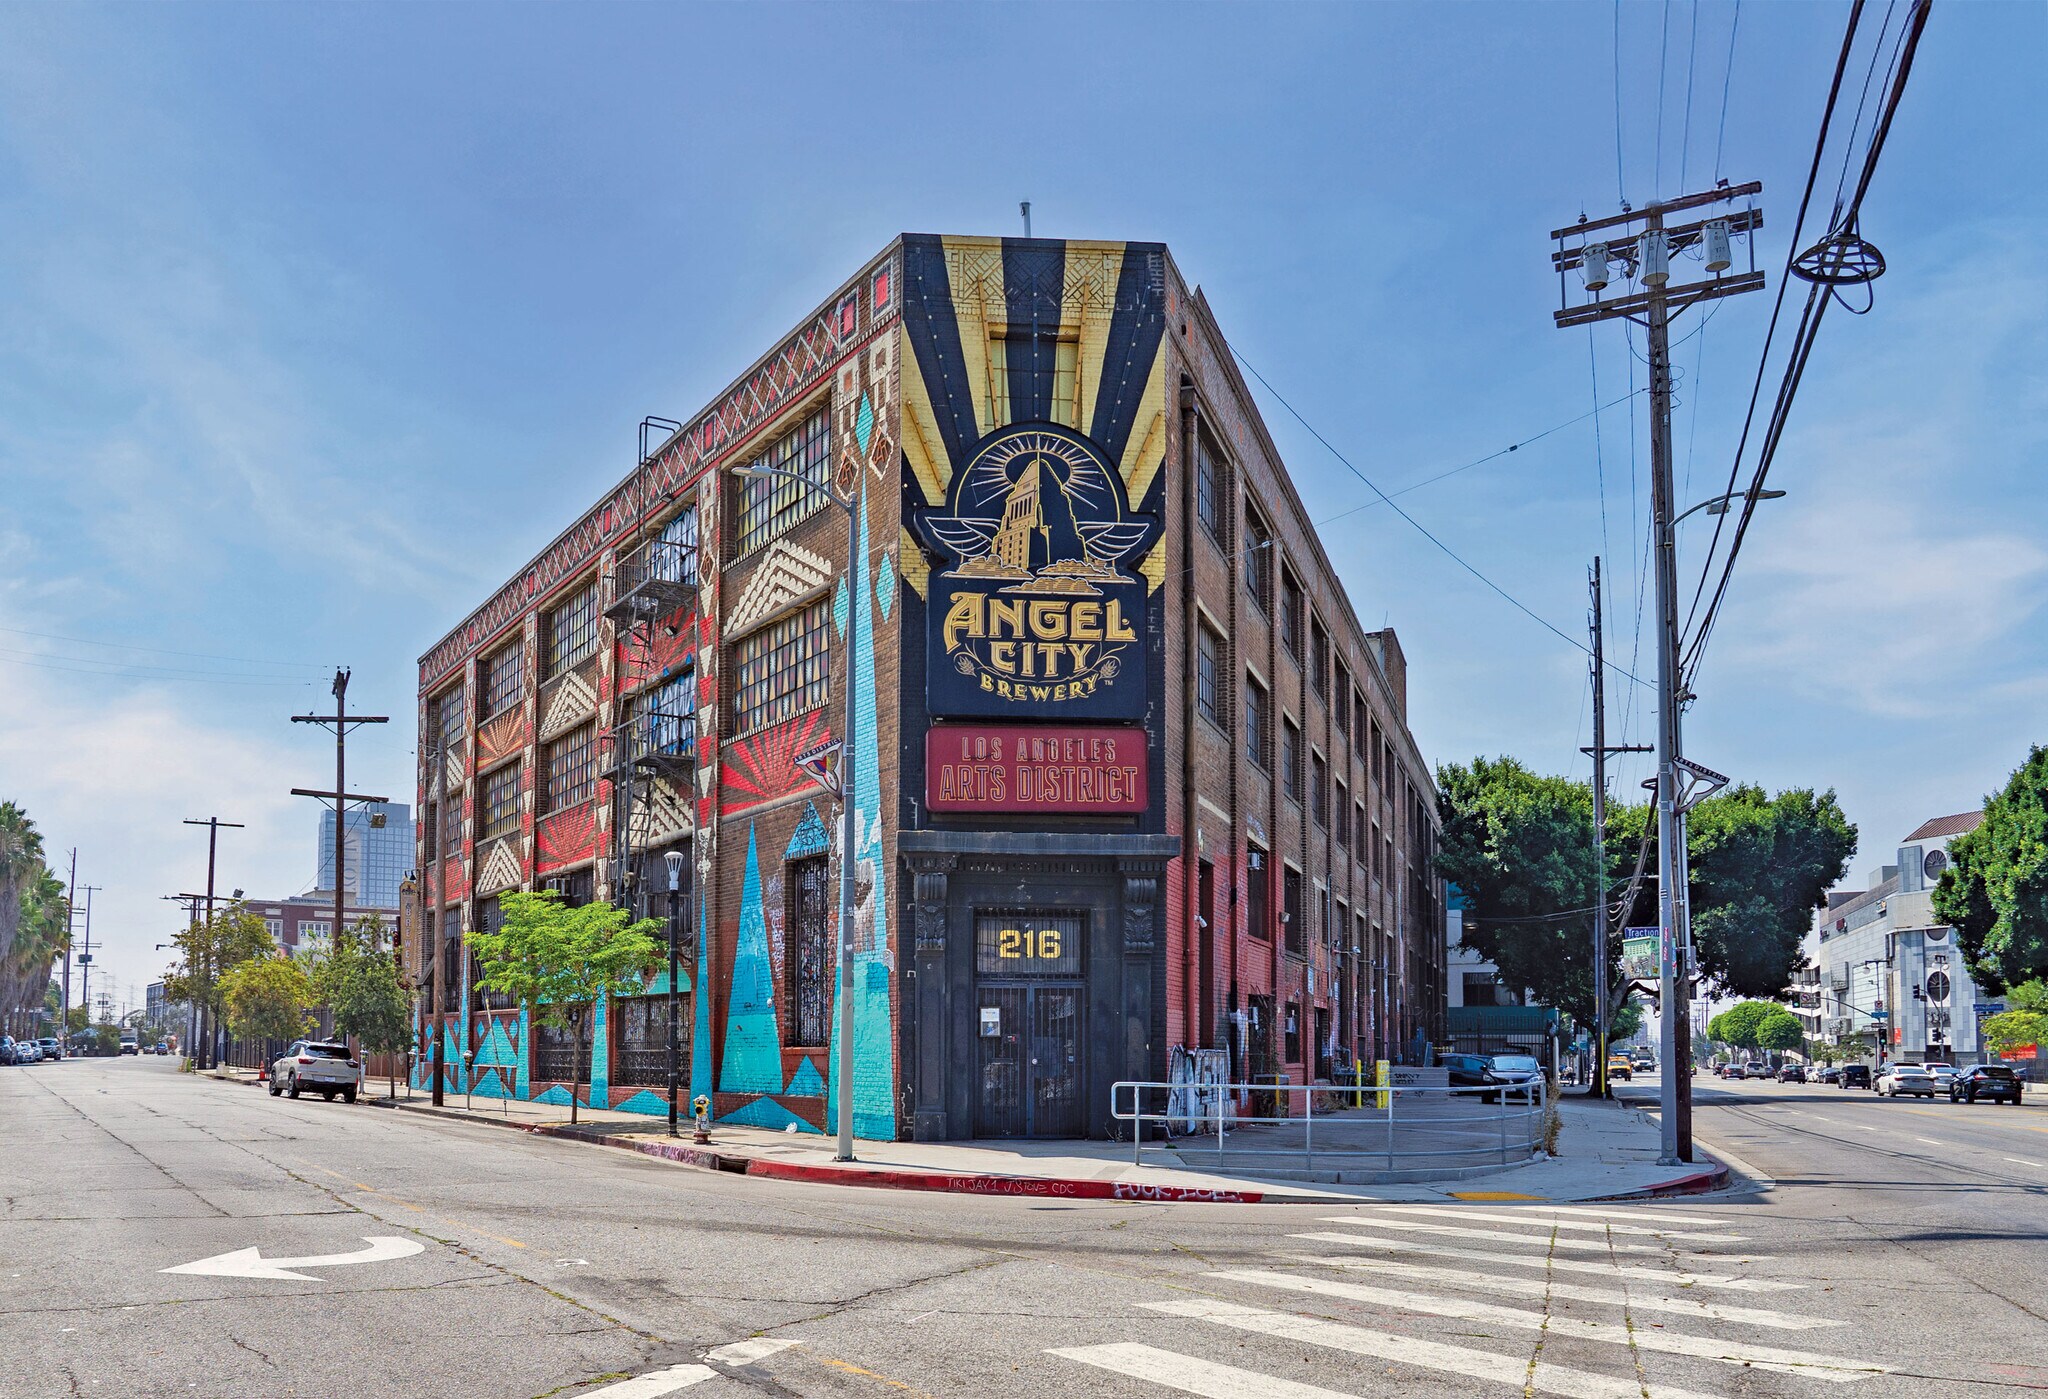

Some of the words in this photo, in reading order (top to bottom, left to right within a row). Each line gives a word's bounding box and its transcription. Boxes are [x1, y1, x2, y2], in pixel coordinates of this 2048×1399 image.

[943, 591, 1138, 654] ANGEL
[989, 641, 1096, 678] CITY
[980, 672, 1100, 702] BREWERY
[793, 751, 811, 763] ARTS
[811, 737, 843, 755] DISTRICT
[962, 737, 1003, 762] LOS
[1016, 738, 1116, 763] ANGELES
[1673, 756, 1693, 768] ARTS
[1694, 764, 1730, 783] DISTRICT
[939, 765, 1006, 802] ARTS
[1016, 766, 1138, 803] DISTRICT
[999, 929, 1061, 959] 216
[1628, 928, 1659, 937] Traction
[1051, 1182, 1076, 1194] CDC
[1111, 1181, 1172, 1200] FUCK
